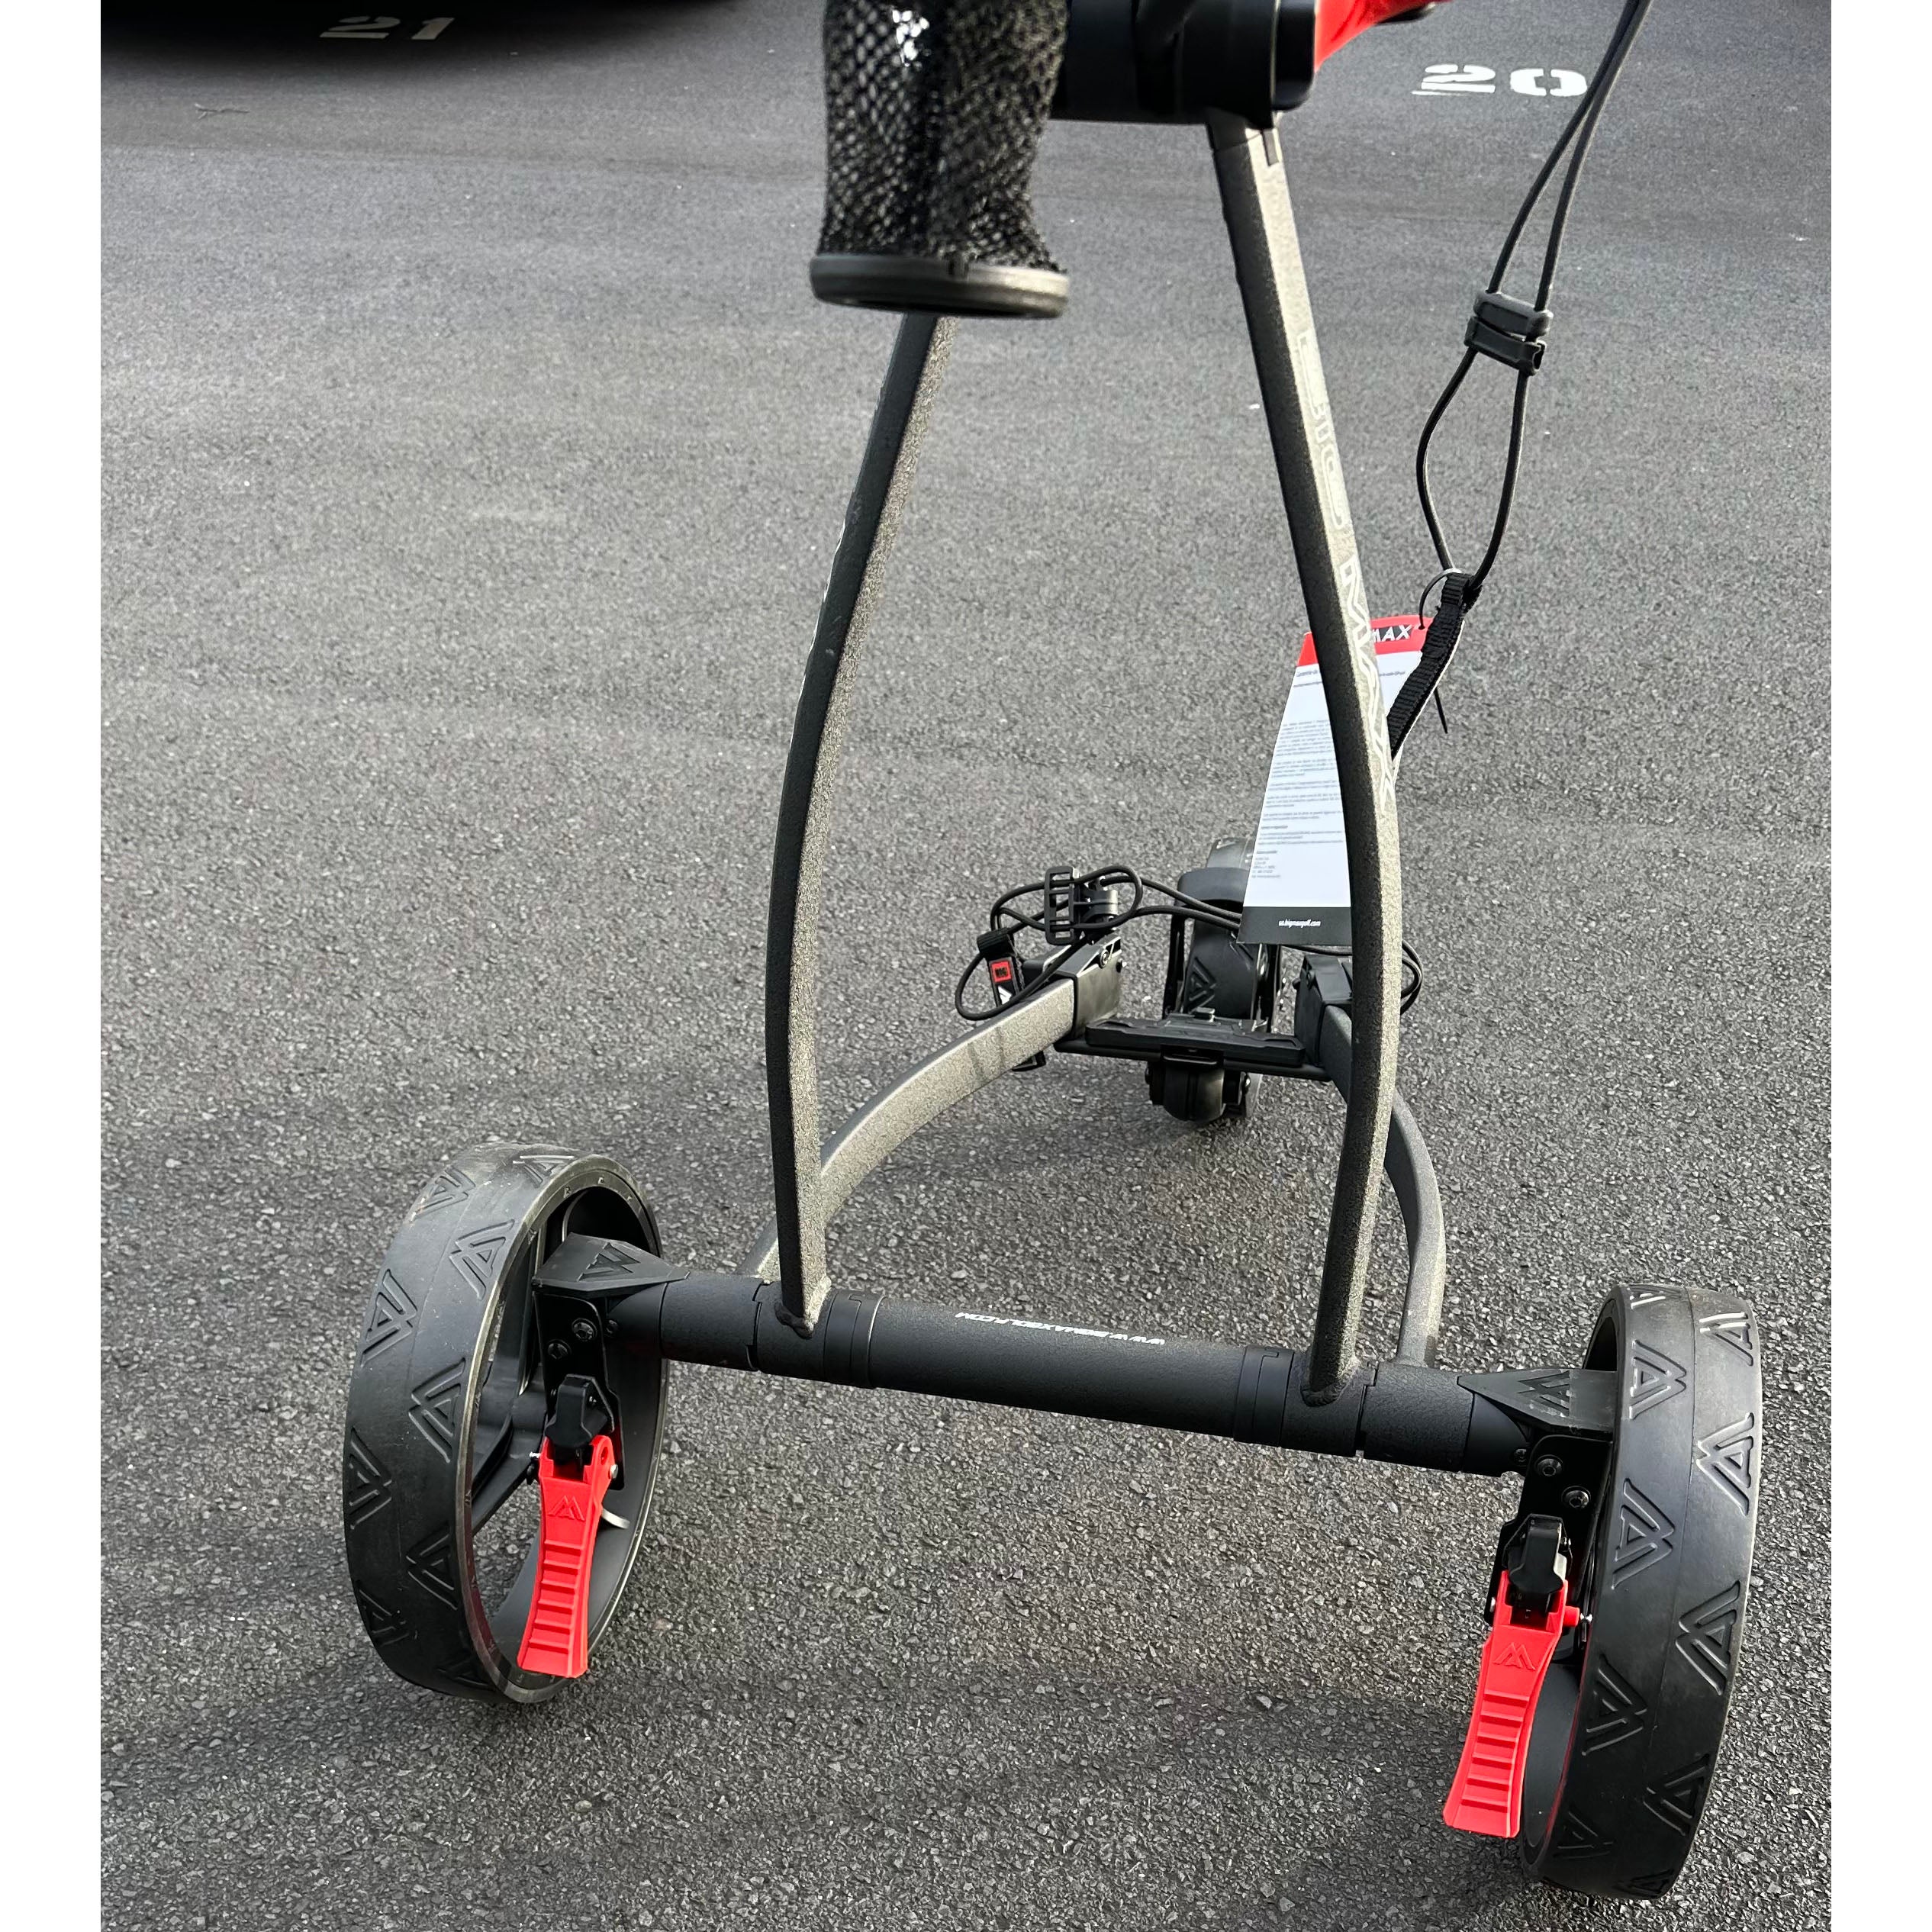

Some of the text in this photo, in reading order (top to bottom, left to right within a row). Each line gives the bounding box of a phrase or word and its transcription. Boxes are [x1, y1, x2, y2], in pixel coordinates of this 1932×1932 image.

[320, 15, 456, 40] 21
[1420, 63, 1588, 97] 20
[1339, 555, 1397, 815] MAX
